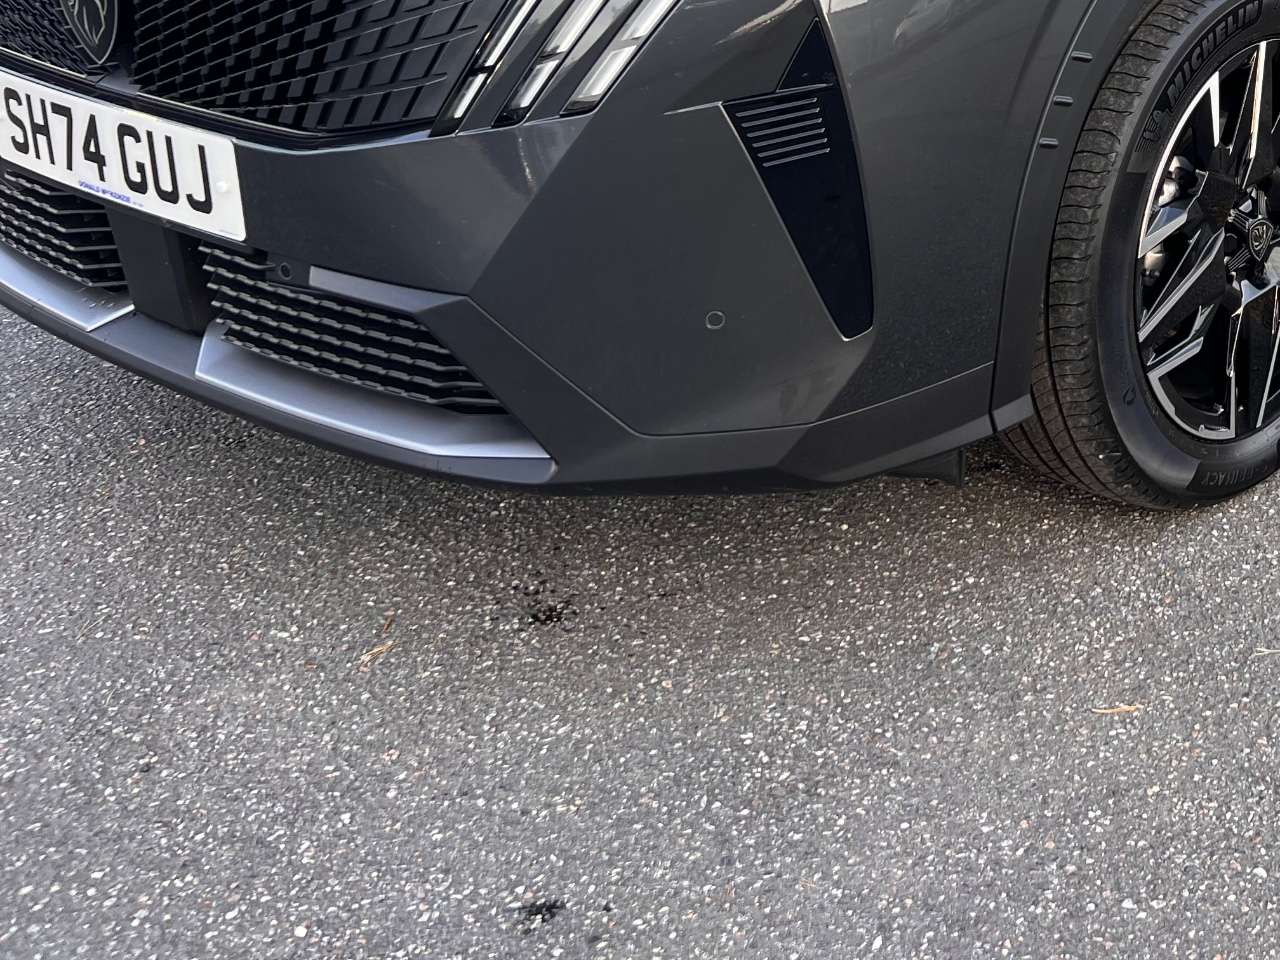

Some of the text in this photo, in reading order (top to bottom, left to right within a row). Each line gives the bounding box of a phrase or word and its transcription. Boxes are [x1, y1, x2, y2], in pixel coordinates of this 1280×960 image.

[1168, 1, 1260, 102] MICHELIN
[4, 86, 213, 213] SH74 GUJ
